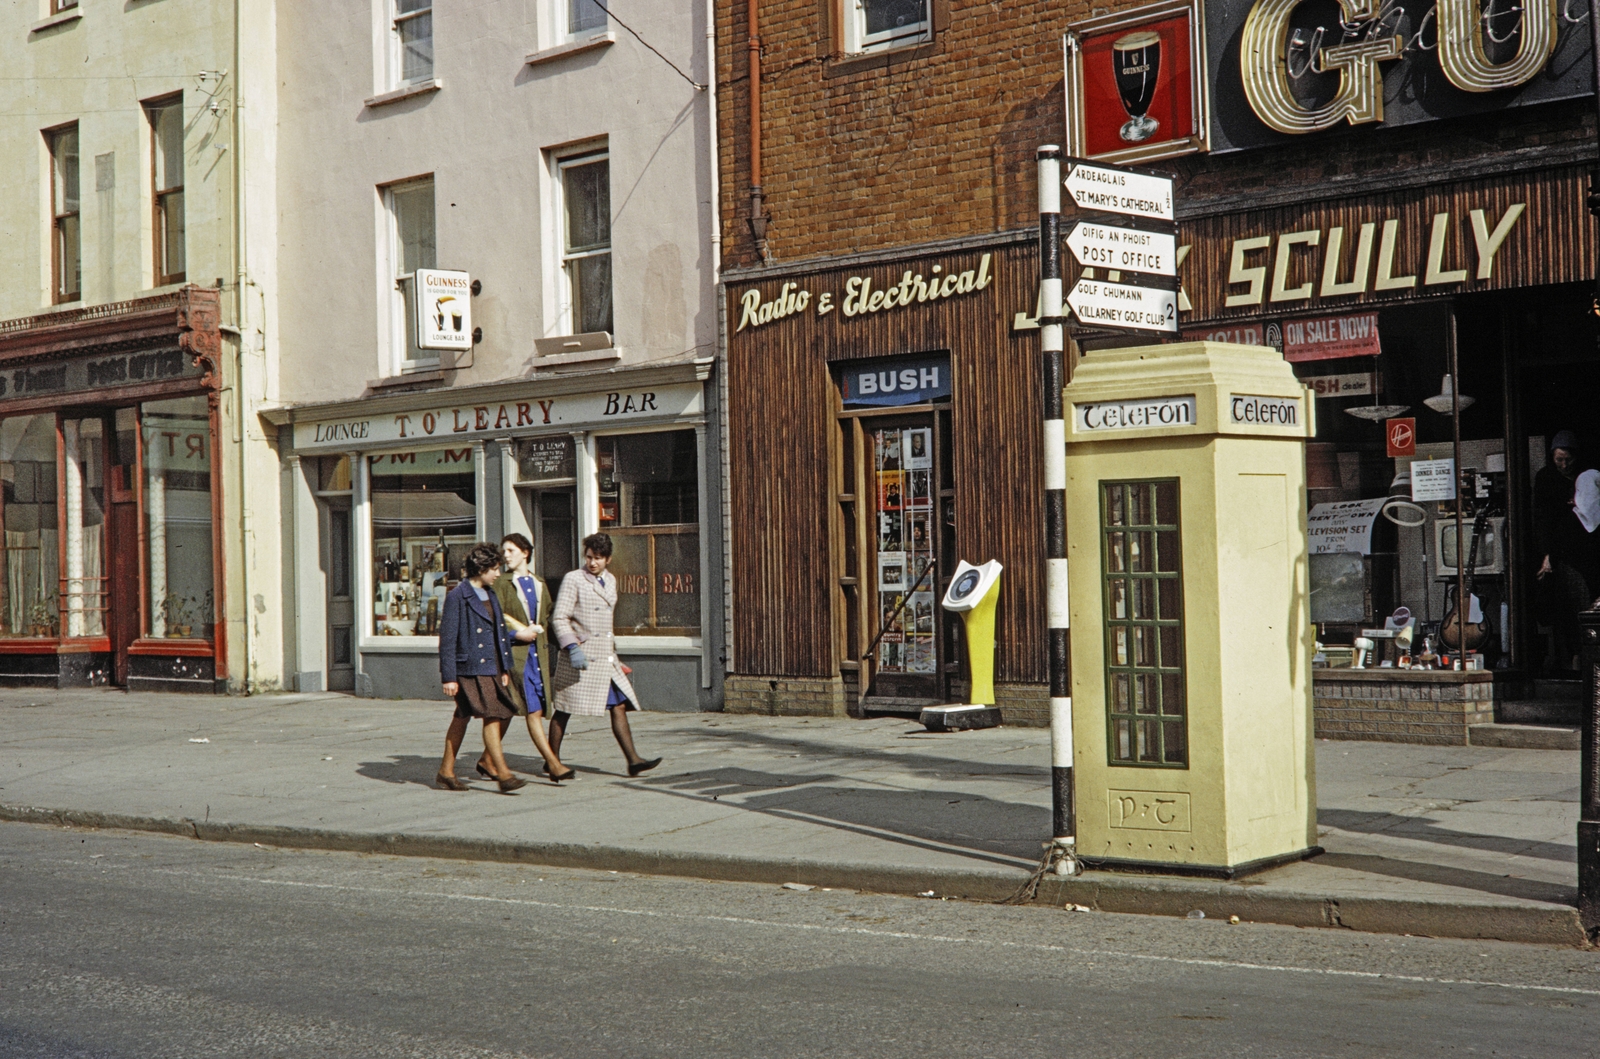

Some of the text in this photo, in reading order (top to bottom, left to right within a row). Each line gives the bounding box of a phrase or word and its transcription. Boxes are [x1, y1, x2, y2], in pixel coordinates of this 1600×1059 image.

[1122, 64, 1150, 75] GUINNESS
[1075, 168, 1126, 186] ARDEAGLAIS
[1120, 197, 1164, 214] CATHEDRAL
[1082, 227, 1151, 246] OIFIG AN PHOIST
[1083, 246, 1161, 269] POST OFFICE
[1224, 202, 1526, 308] SCULLY
[426, 275, 467, 289] GUINNESS
[736, 282, 812, 332] Radio
[842, 253, 992, 317] Electrical
[1078, 283, 1142, 301] GOLF CHUMANN
[1078, 303, 1174, 326] KILLARNEY GOLF CLUB 2
[1287, 322, 1305, 346] ON
[1307, 319, 1337, 343] SALE
[1339, 314, 1375, 340] NOW!
[858, 366, 939, 395] BUSH
[1342, 381, 1367, 391] dealer
[313, 421, 370, 443] LOUNGE
[604, 392, 658, 416] BAR
[1331, 502, 1364, 510] LOOK
[1308, 514, 1340, 522] RENT
[1350, 511, 1376, 519] OWN
[1307, 525, 1367, 536] ELEVISION SET
[662, 572, 694, 595] BAR
